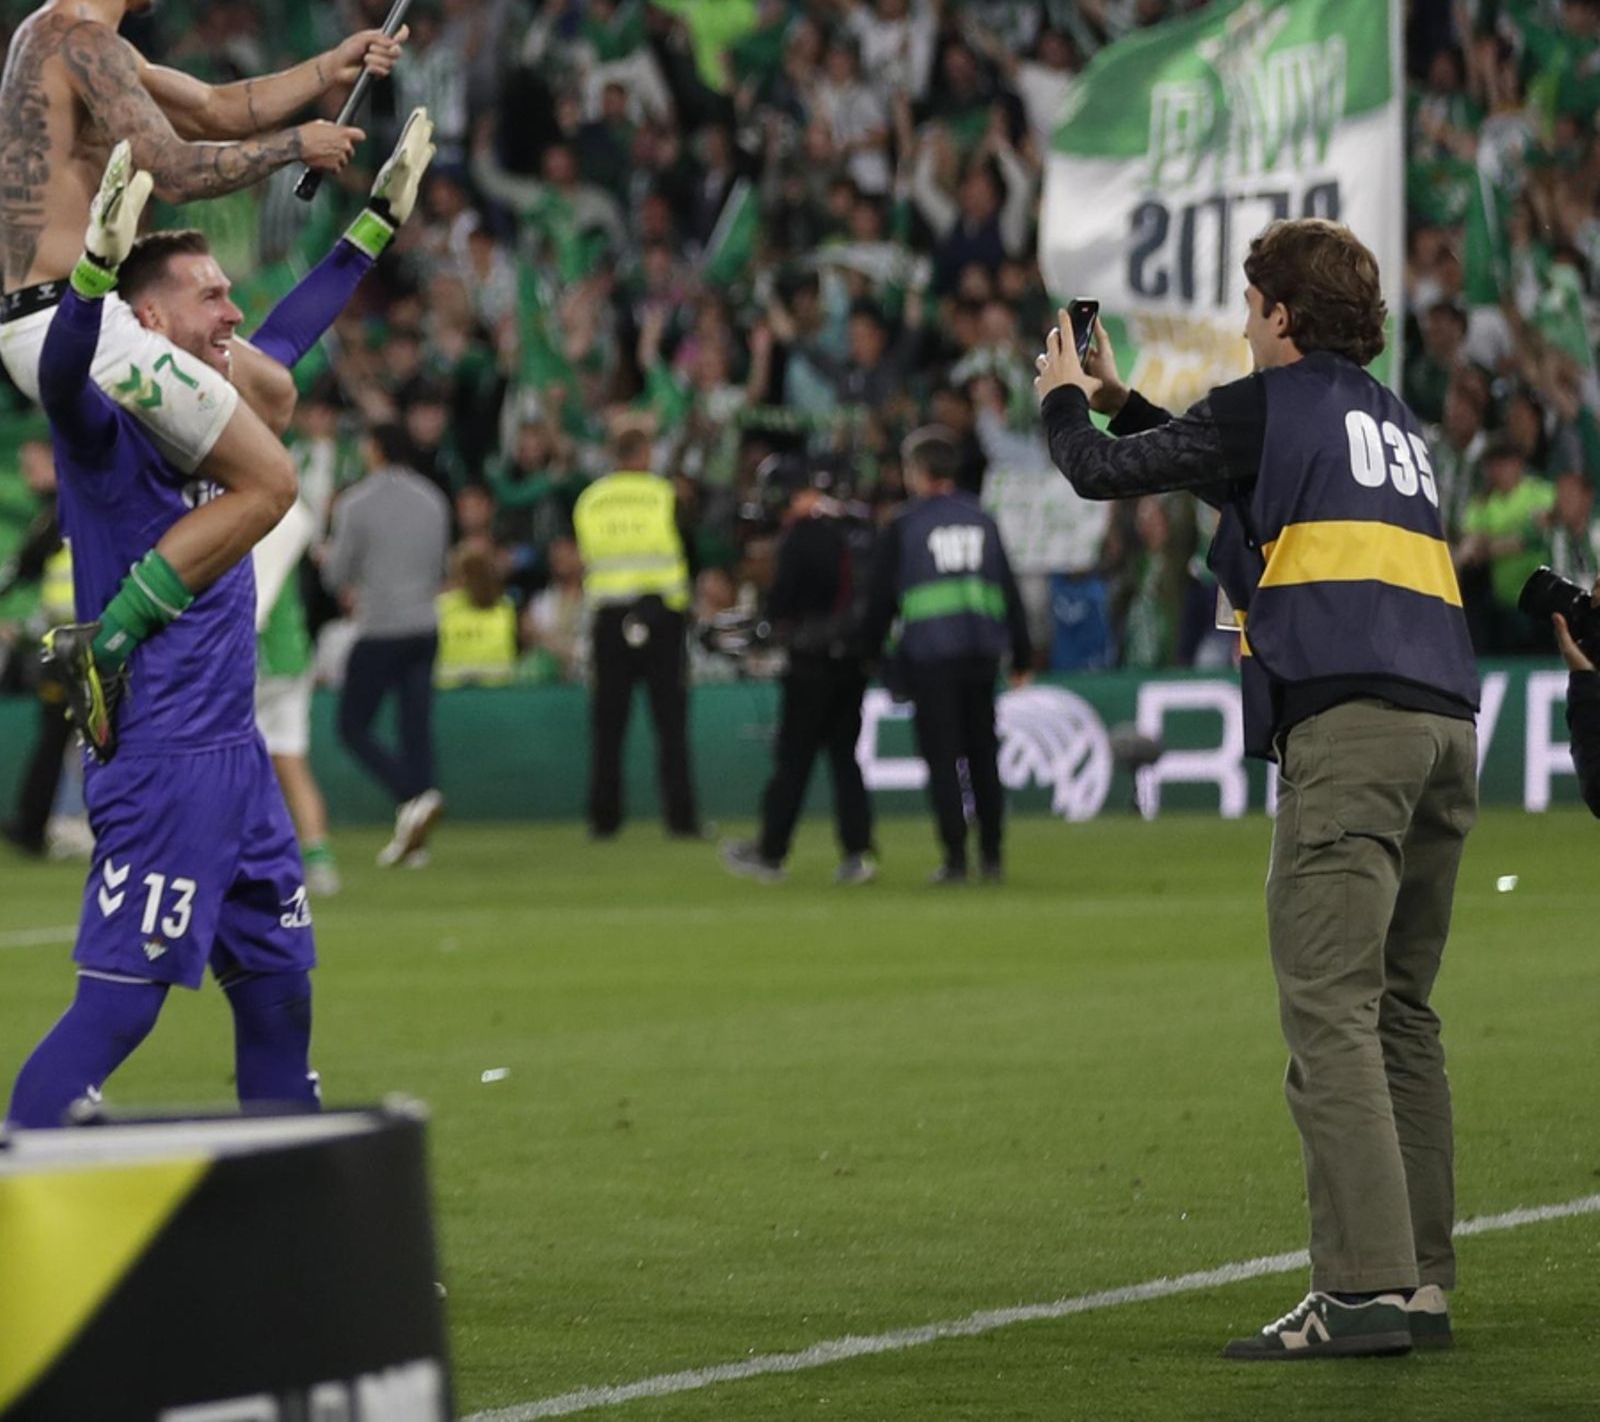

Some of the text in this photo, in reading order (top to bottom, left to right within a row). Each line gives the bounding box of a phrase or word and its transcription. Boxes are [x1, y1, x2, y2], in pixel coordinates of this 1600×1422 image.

[153, 352, 200, 390] 7
[1344, 409, 1439, 509] 035
[140, 872, 197, 939] 13
